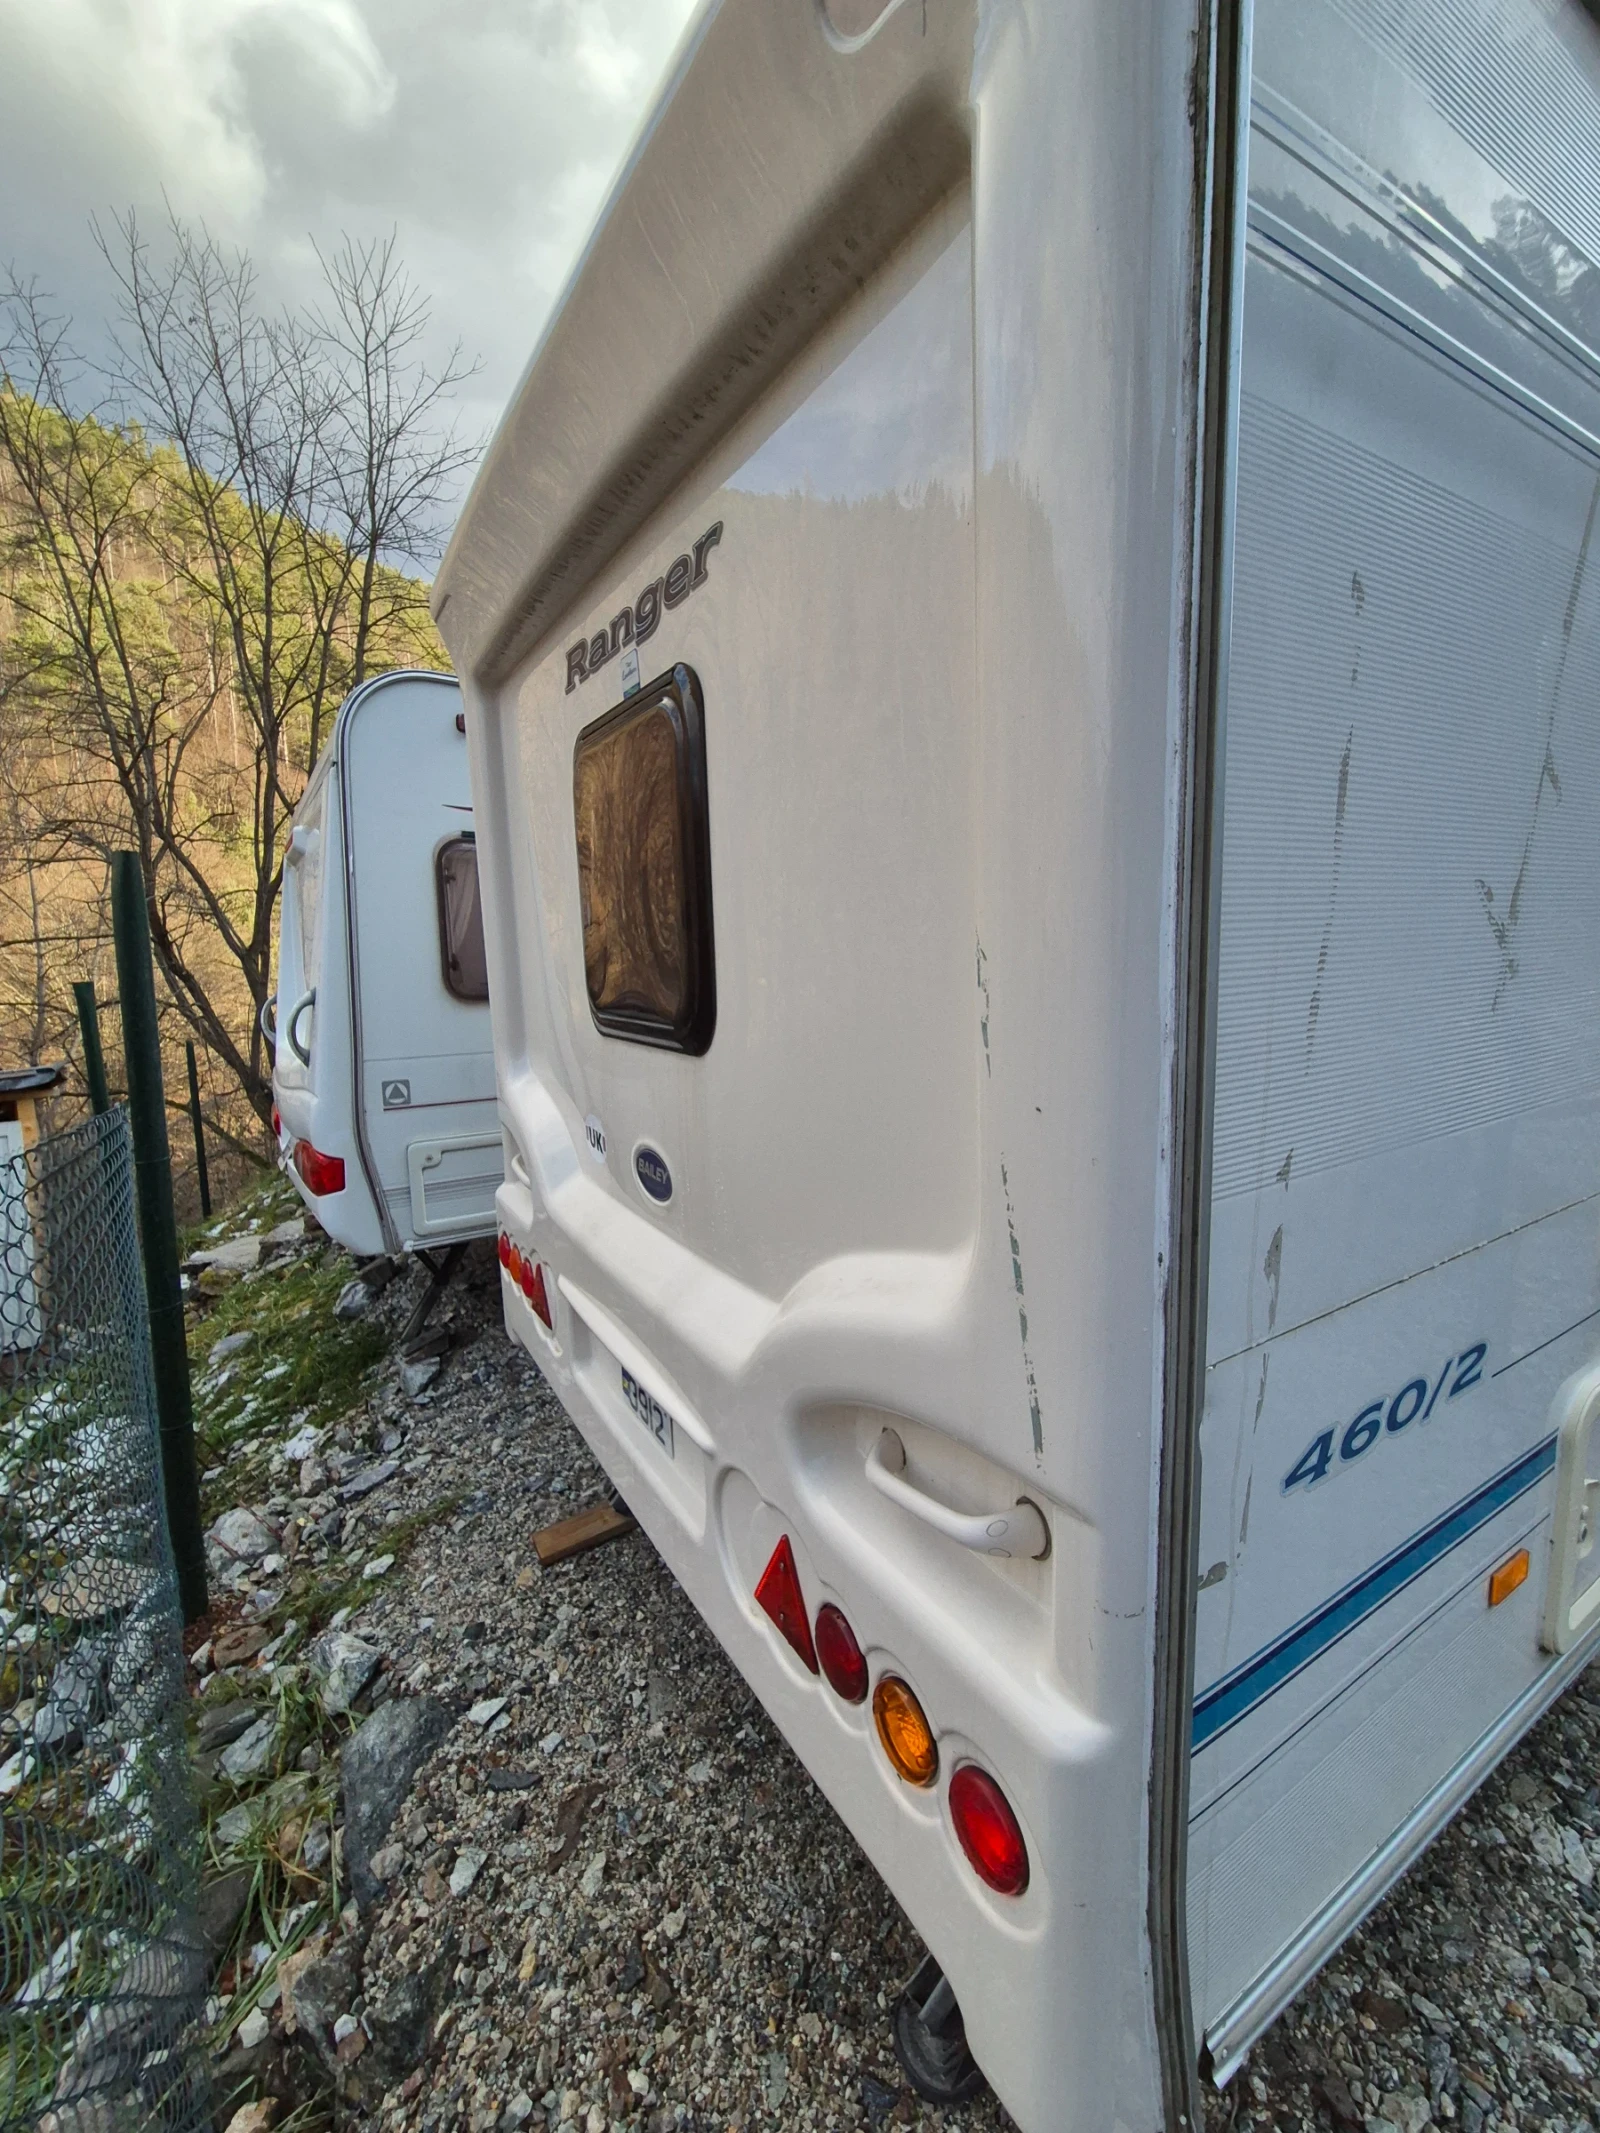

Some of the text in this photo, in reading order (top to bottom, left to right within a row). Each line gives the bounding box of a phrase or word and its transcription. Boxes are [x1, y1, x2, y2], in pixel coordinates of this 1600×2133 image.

[565, 521, 724, 695] Ranger
[588, 1126, 604, 1154] UK
[638, 1158, 669, 1184] BAILEY
[1284, 1342, 1487, 1489] 460/2
